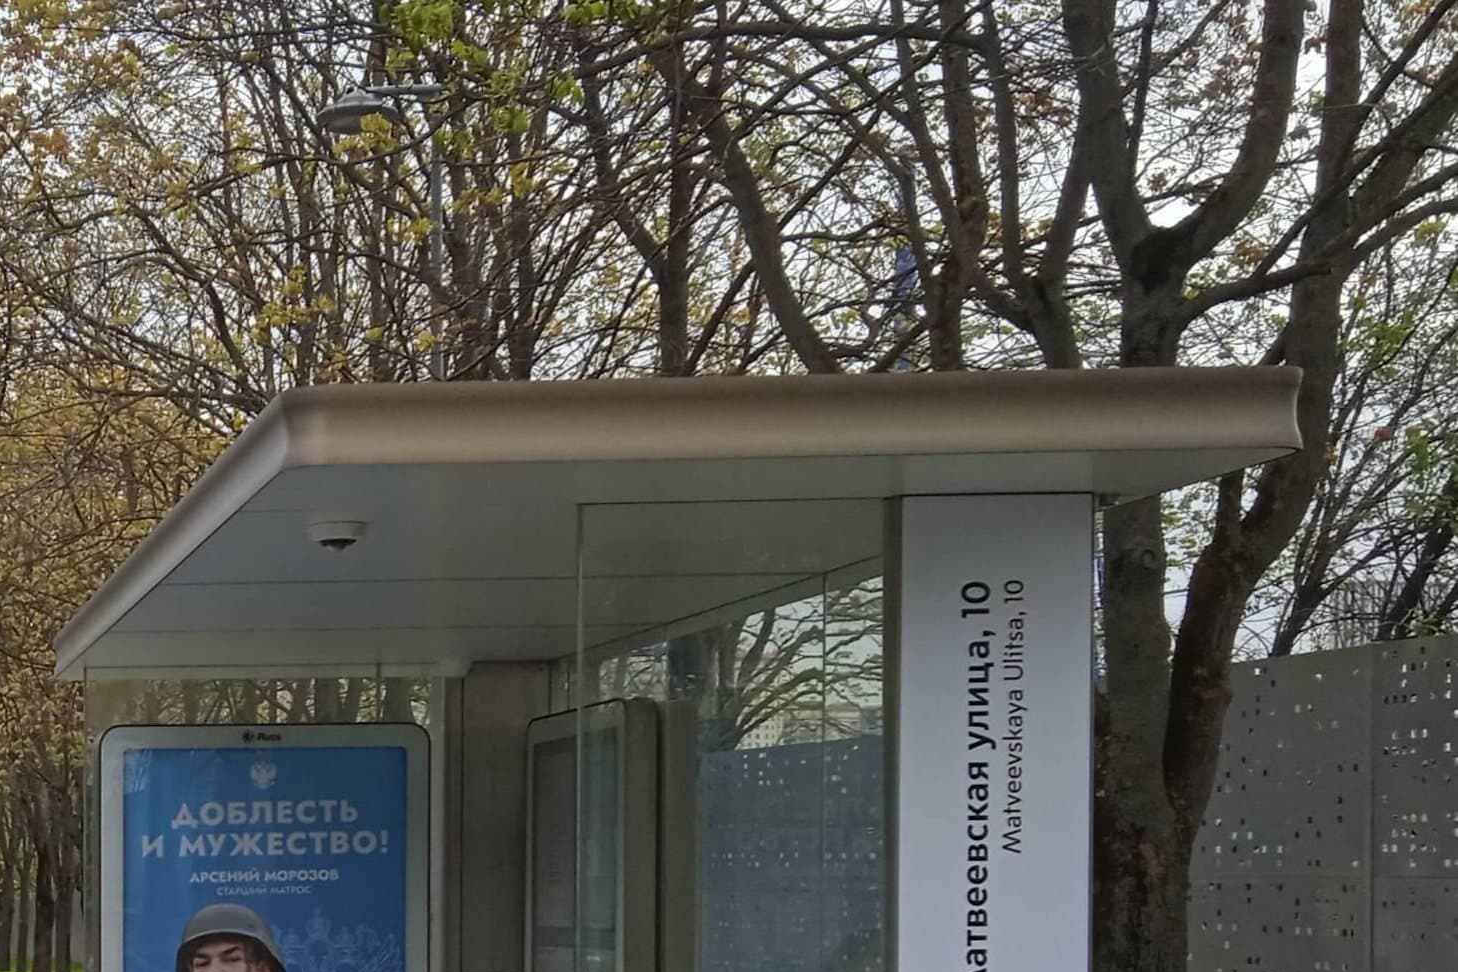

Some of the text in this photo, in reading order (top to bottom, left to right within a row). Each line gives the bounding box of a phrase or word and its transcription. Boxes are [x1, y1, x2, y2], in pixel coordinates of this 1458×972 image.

[960, 580, 991, 619] 10
[967, 629, 997, 751] улица,
[1002, 579, 1028, 854] Matveevskaya Ulitsa, 10
[170, 798, 359, 830] ДОБЛЕСТЬ
[141, 829, 390, 858] И МУЖЕСТВО!
[189, 866, 340, 884] АРСЕНИЙ МОРОЗОВ
